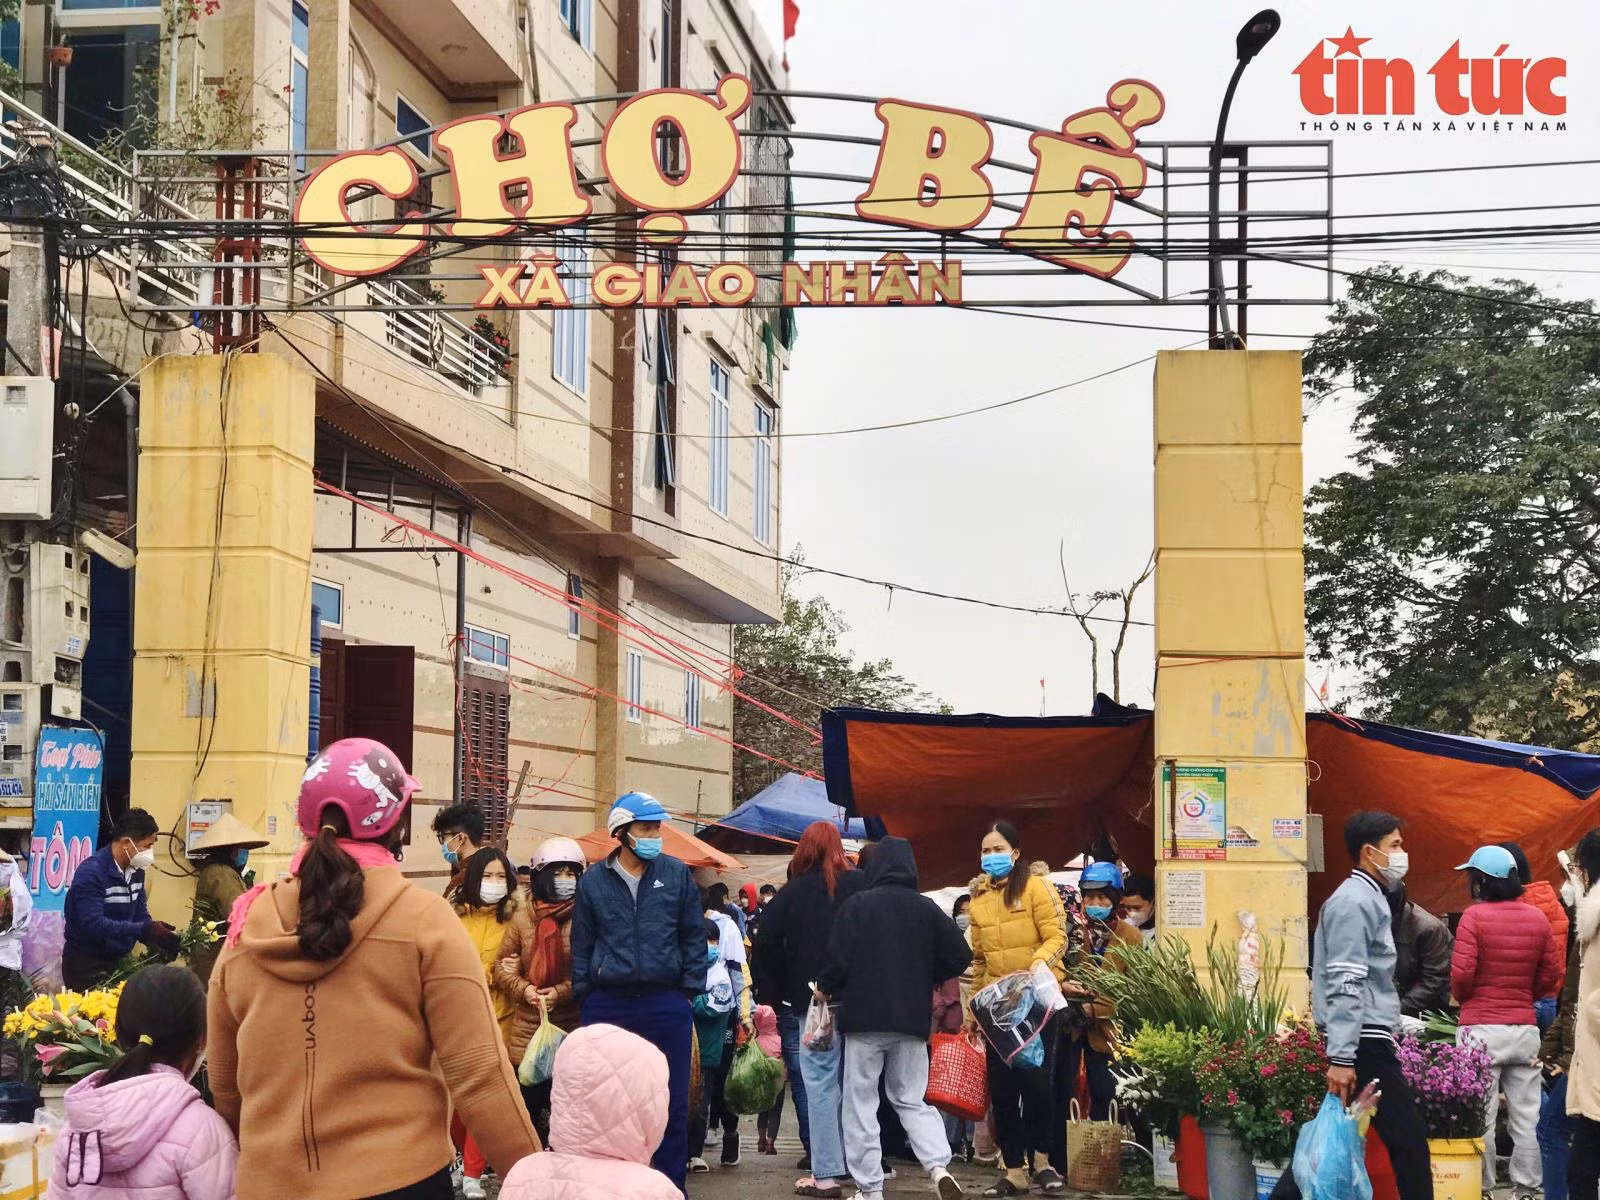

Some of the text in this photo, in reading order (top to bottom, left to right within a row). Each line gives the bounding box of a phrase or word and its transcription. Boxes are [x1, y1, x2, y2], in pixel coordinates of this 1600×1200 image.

[296, 74, 1165, 279] CHỢ BỂ
[477, 251, 962, 309] XÃ GIAO NHÂN
[38, 773, 100, 812] HẢI SẢN BIỂN
